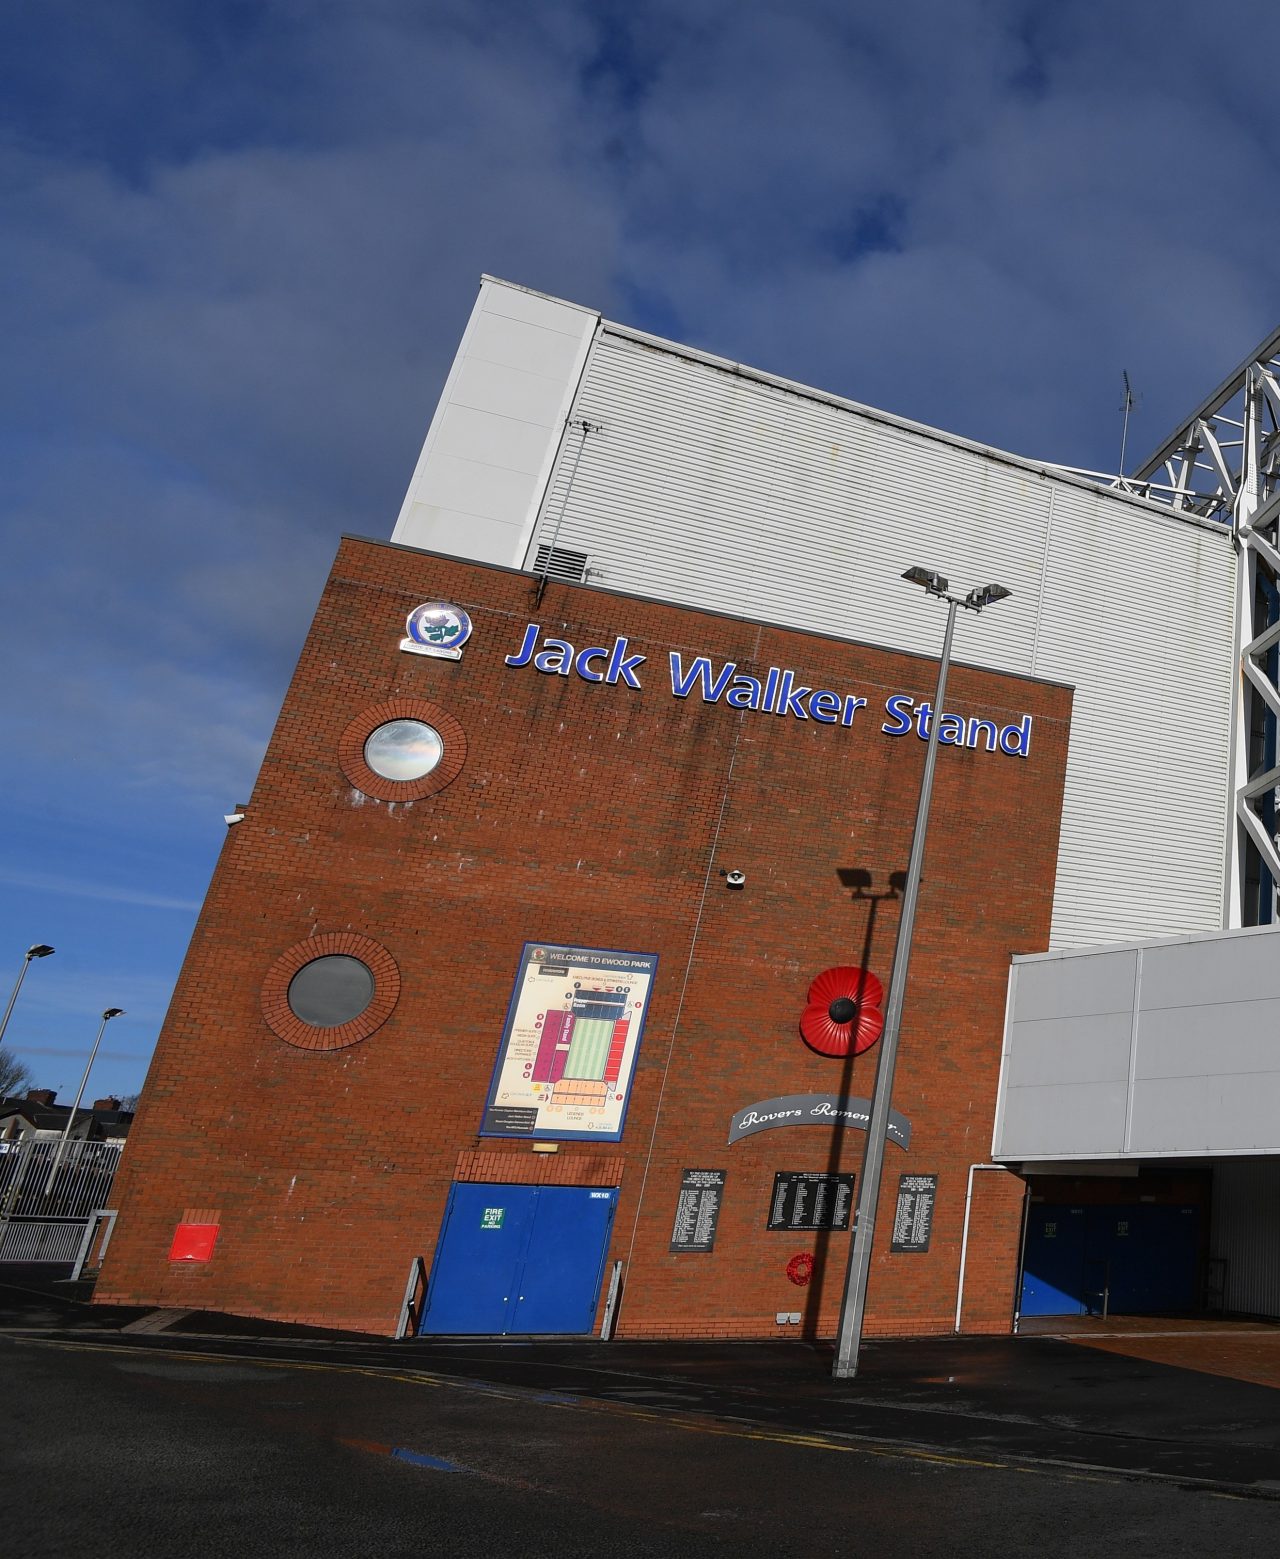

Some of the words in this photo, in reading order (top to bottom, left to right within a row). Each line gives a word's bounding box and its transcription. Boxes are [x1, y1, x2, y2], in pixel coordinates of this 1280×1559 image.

[504, 622, 647, 688] Jack
[668, 651, 867, 727] Walker
[881, 694, 1033, 757] Stand
[550, 953, 590, 964] WELCOME
[590, 957, 601, 965] TO
[601, 958, 630, 968] EWOOD
[630, 961, 652, 969] PARK
[738, 1107, 802, 1130] Rovers
[483, 1214, 502, 1222] EXIT
